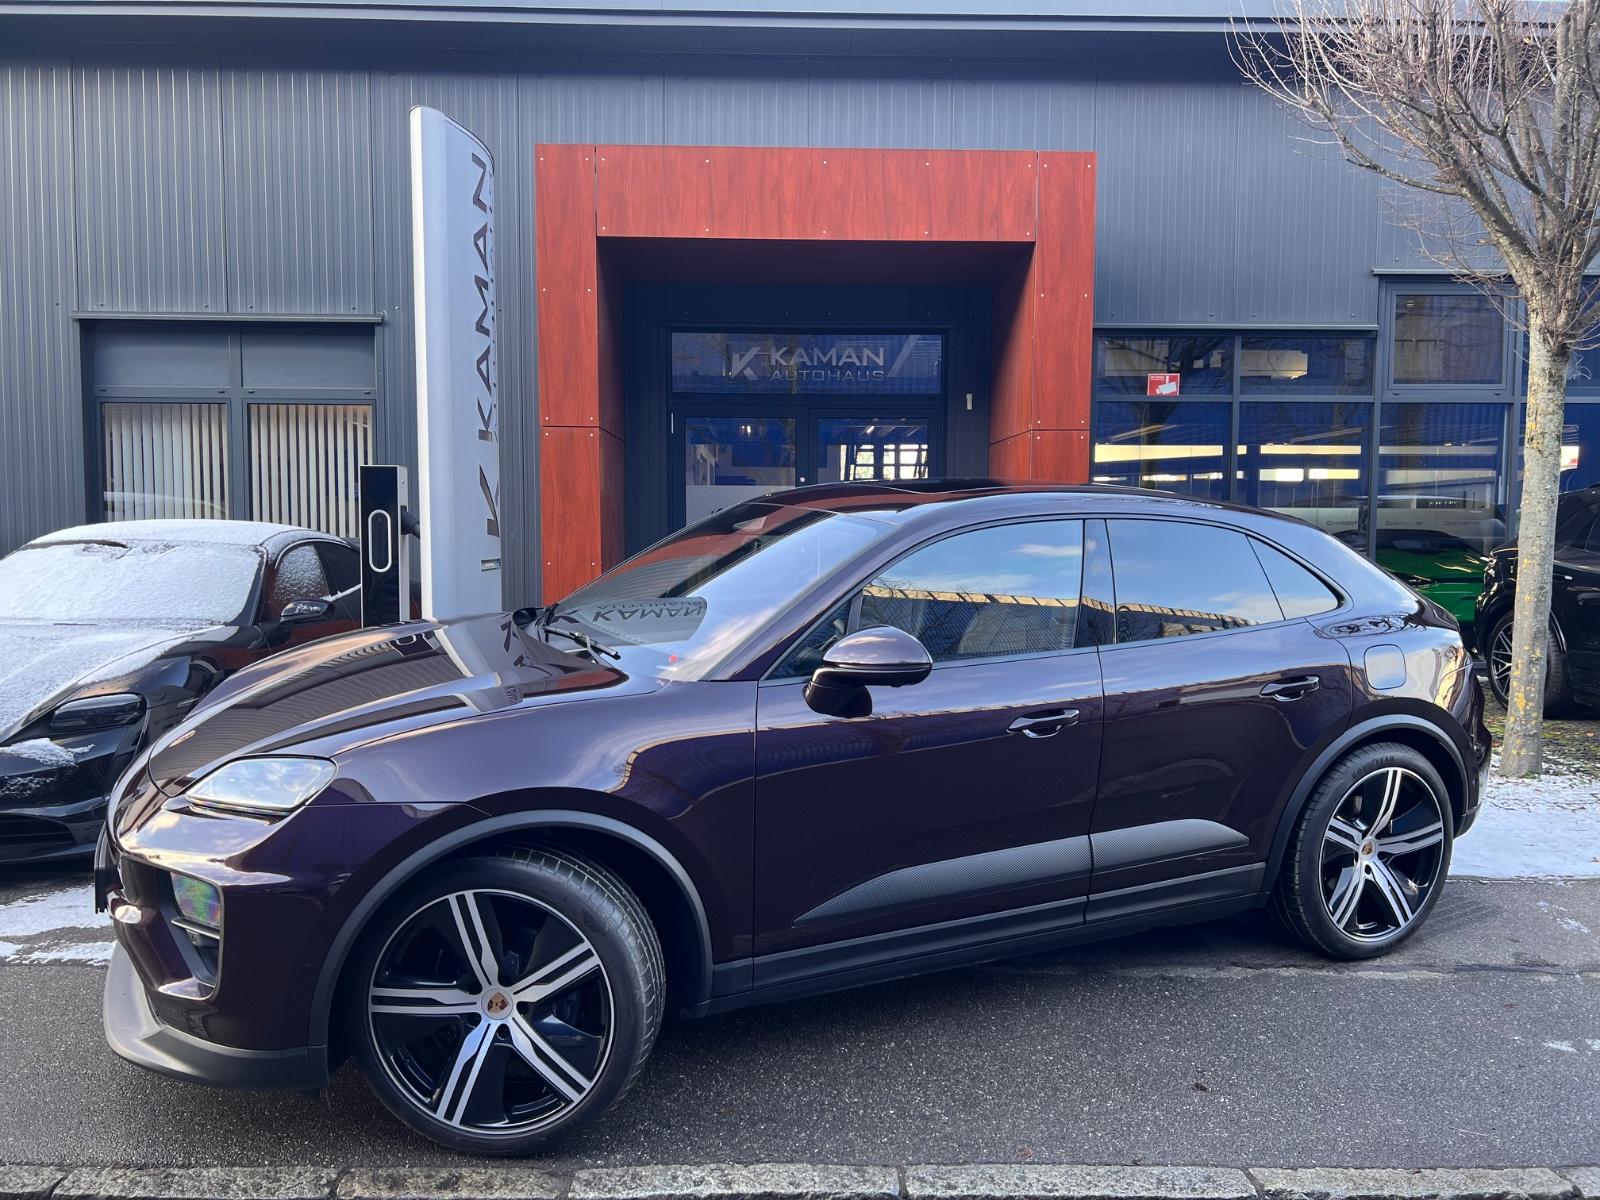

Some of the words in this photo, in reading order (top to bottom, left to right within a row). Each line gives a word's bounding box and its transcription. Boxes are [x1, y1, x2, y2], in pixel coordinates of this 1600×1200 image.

[471, 152, 493, 441] KAMAN
[770, 347, 884, 366] KAMAN
[770, 370, 884, 381] AUTOHAUS
